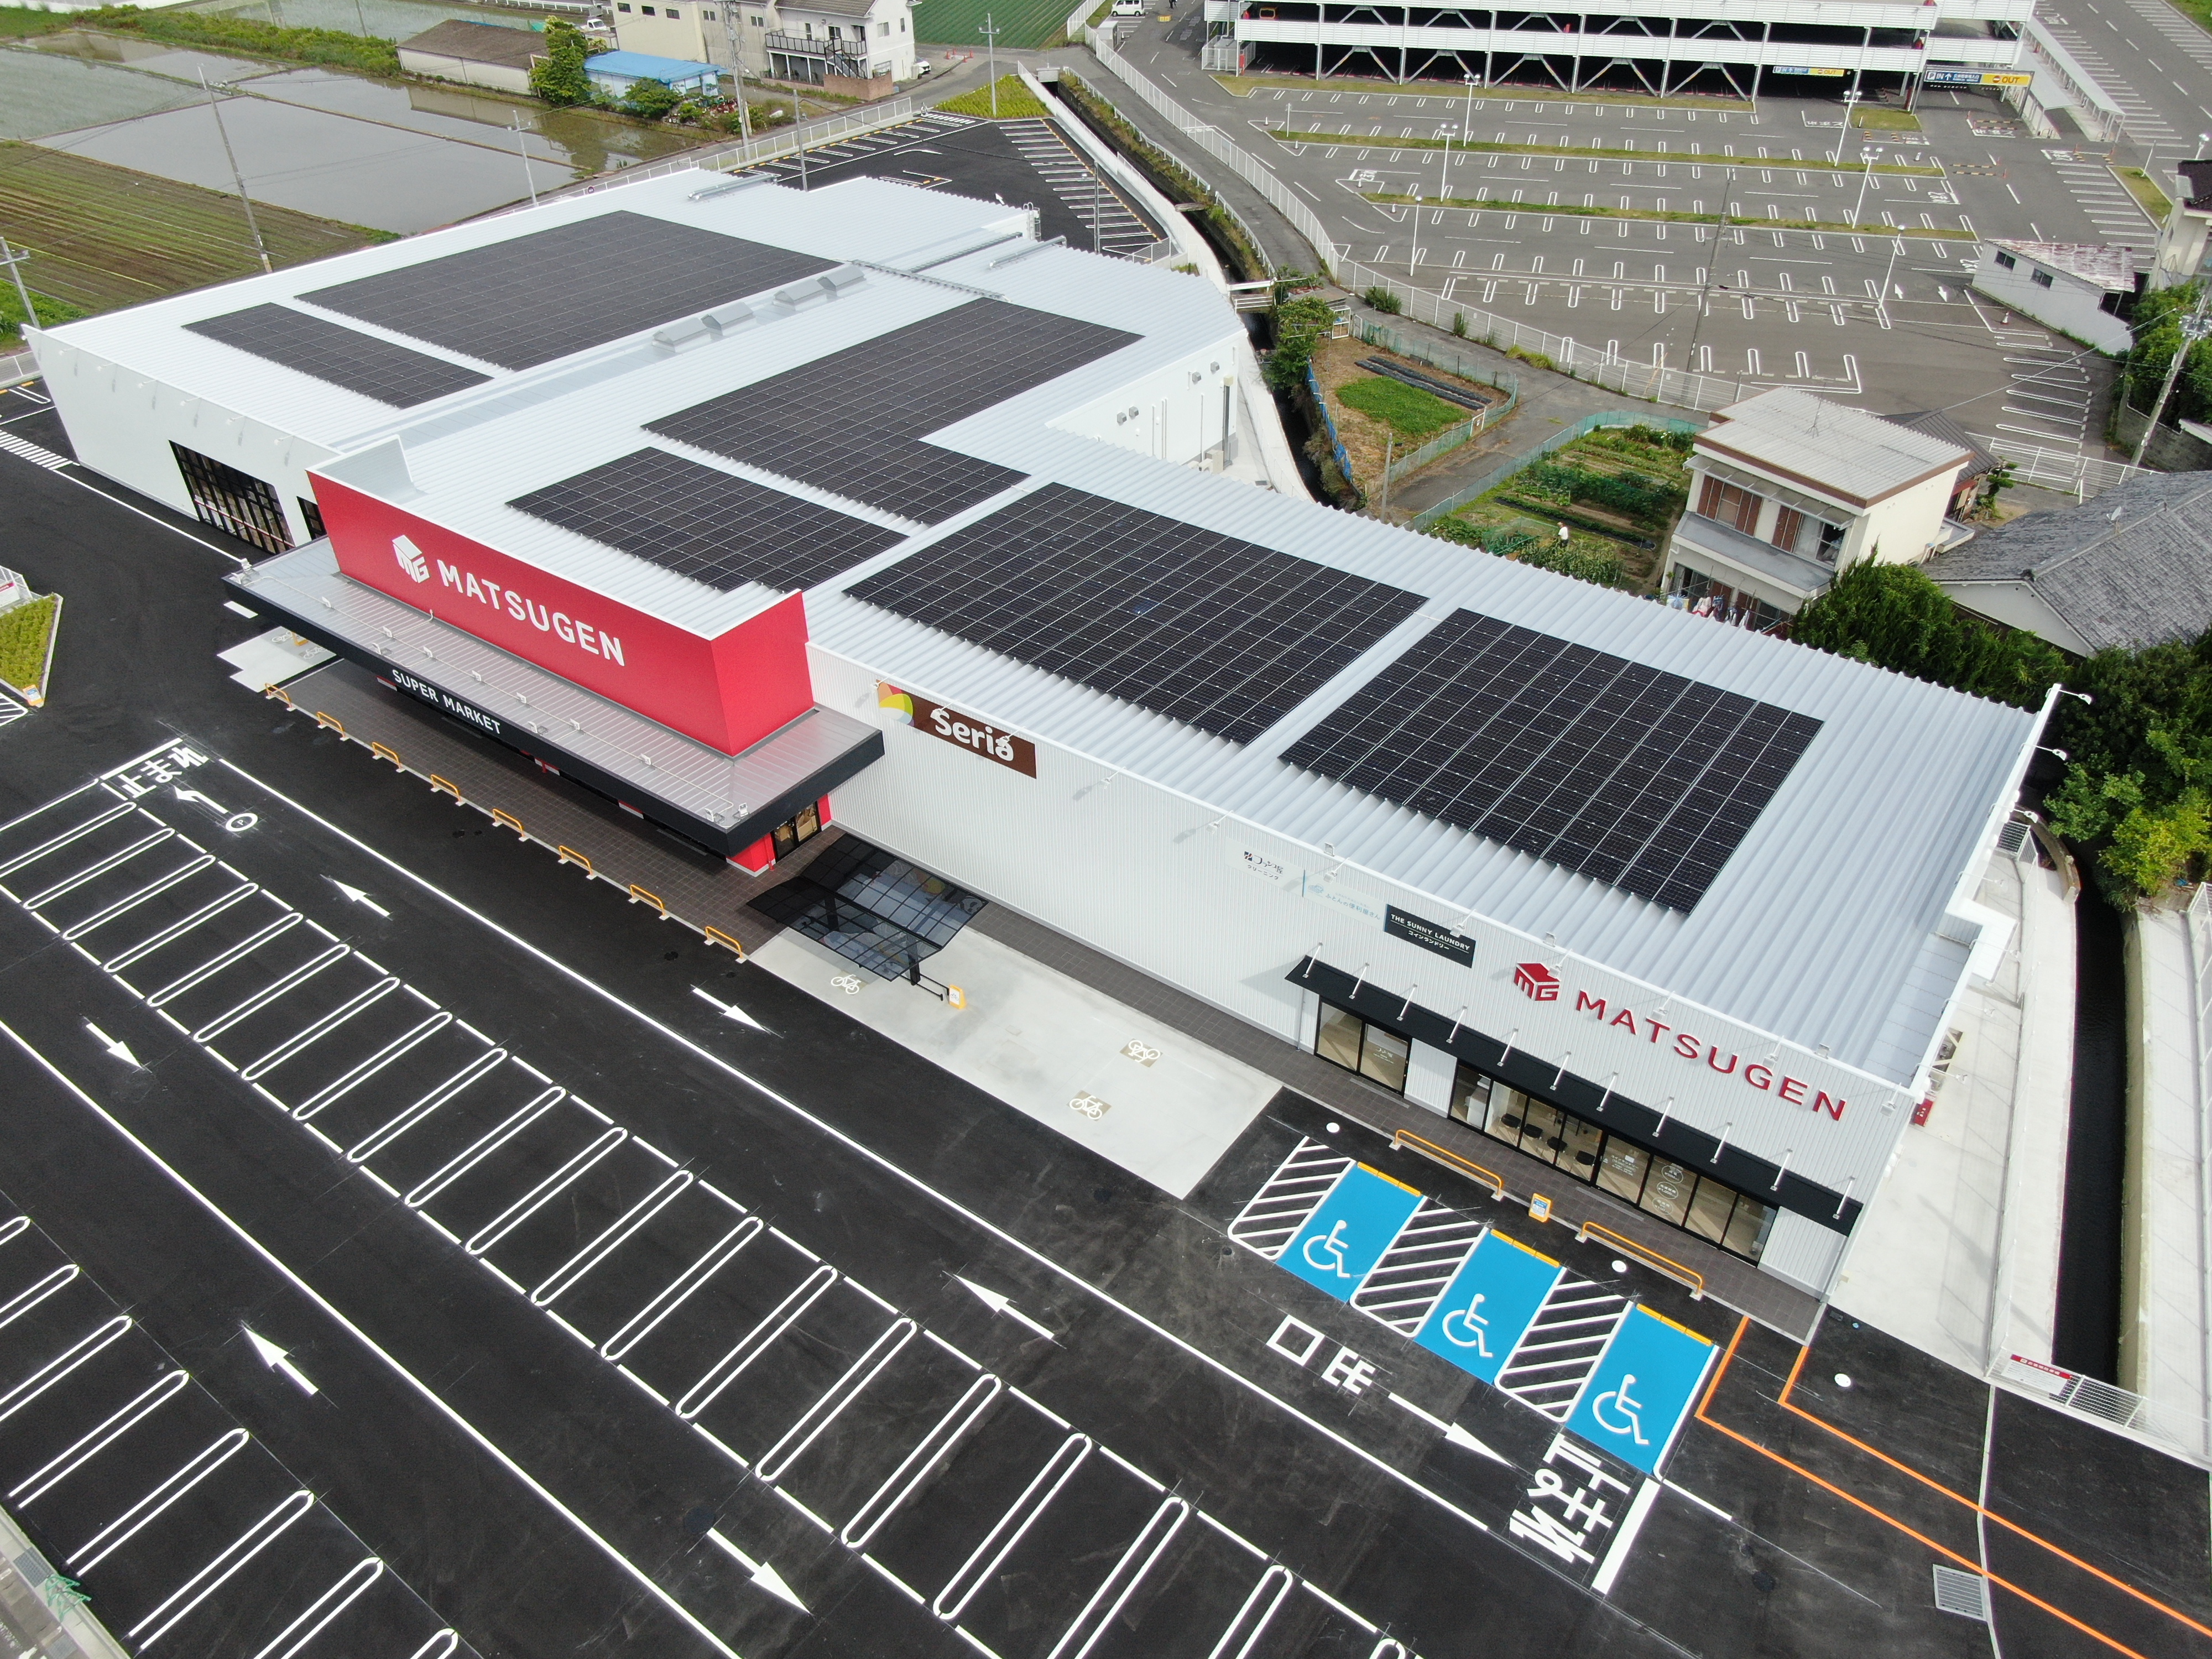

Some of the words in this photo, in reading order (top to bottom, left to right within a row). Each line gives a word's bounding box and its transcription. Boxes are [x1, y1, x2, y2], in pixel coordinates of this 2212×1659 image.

[436, 559, 625, 667] MATSUGEN
[392, 669, 439, 702] SUPER
[443, 695, 500, 734] MARKET
[934, 710, 1014, 762] Seria
[118, 747, 209, 798] 止まれ
[1247, 864, 1279, 880] クリーニング
[1325, 893, 1380, 920] ふとんの便利屋さん
[1391, 914, 1405, 924] THE
[1407, 921, 1432, 935] SUNNY
[1434, 932, 1470, 951] LAUNDRY
[1408, 930, 1449, 950] コインランドリー
[1575, 989, 1847, 1121] MATSUGEN
[1509, 1433, 1632, 1564] 止まれ
